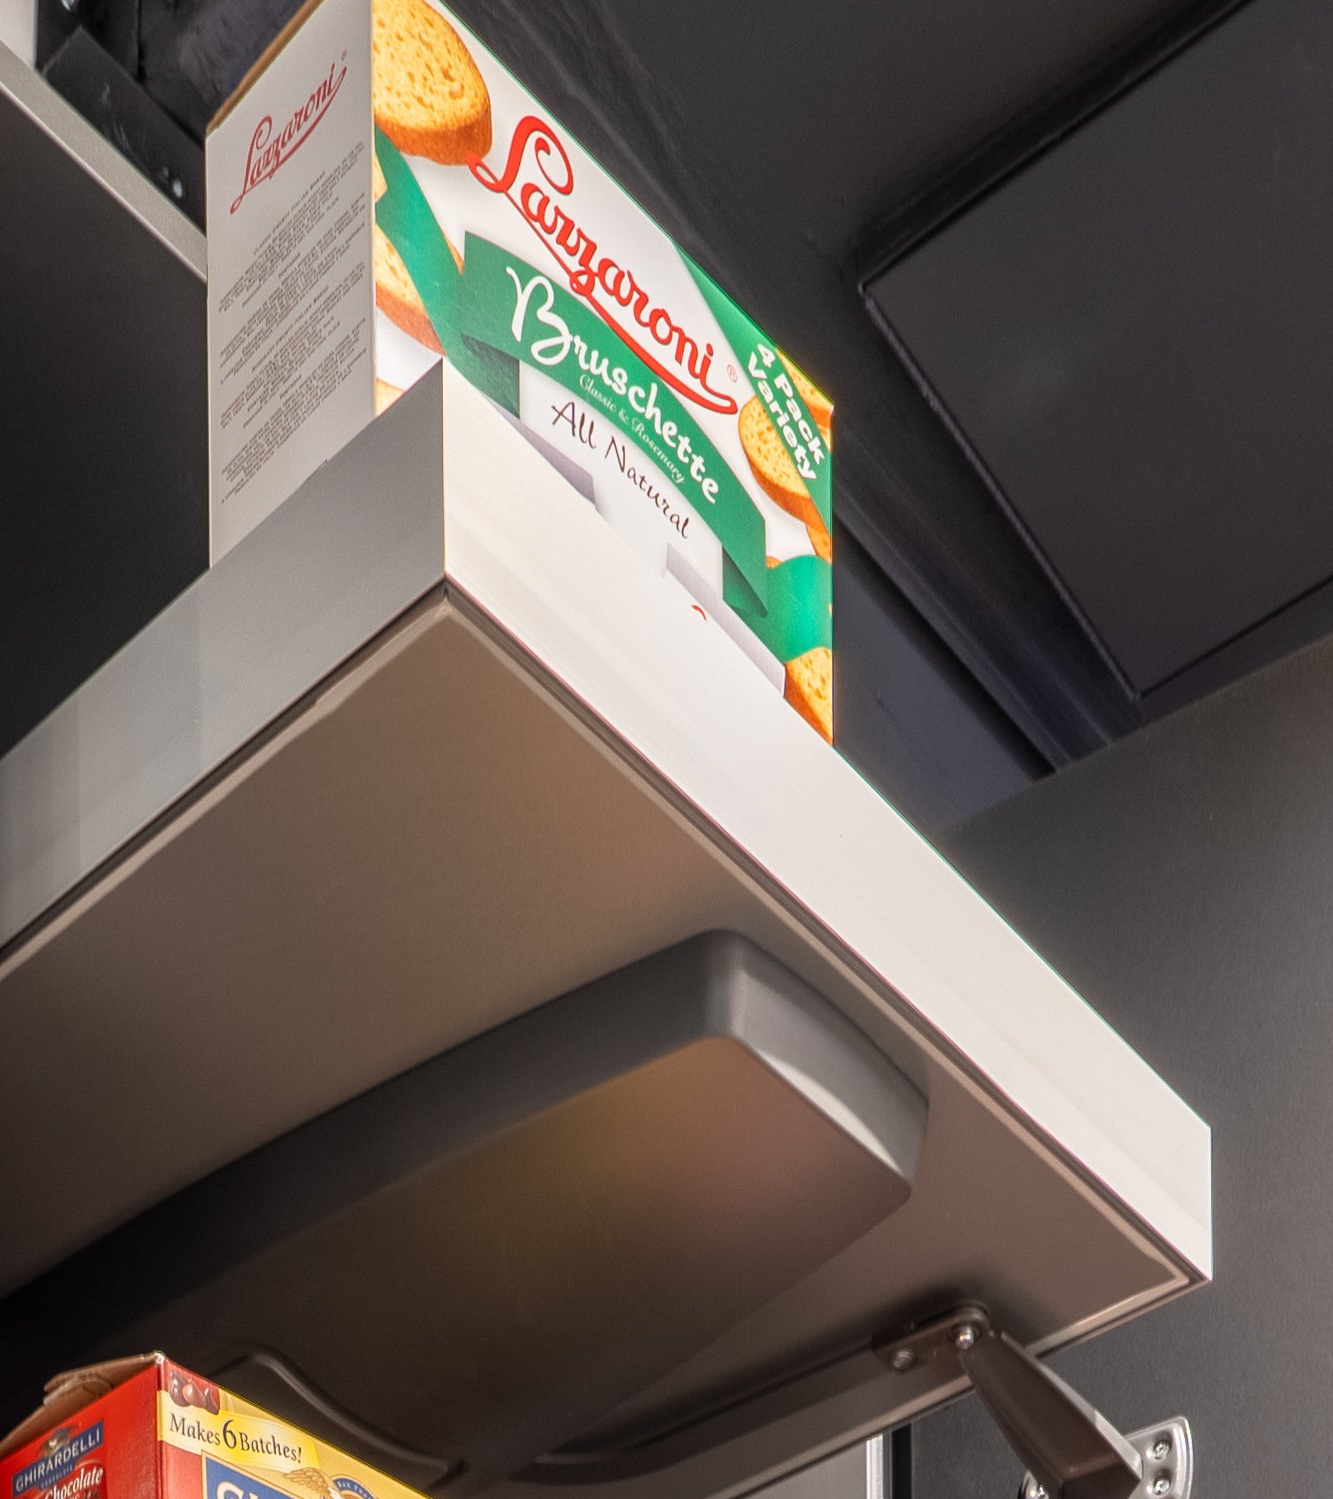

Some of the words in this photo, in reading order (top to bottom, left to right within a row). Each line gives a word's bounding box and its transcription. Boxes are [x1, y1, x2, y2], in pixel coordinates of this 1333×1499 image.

[230, 62, 347, 215] Lazzaroni
[468, 114, 738, 415] Lazzaroni
[506, 266, 718, 504] Bruschette
[579, 375, 617, 413] Classic
[631, 418, 685, 484] Rosemary
[748, 352, 816, 480] Variety
[757, 344, 776, 368] 4
[774, 373, 826, 465] Pack
[551, 401, 596, 449] All
[605, 436, 689, 539] Natural
[15, 1428, 101, 1493] GHIRARDELLI
[170, 1413, 221, 1446] Makes
[222, 1419, 237, 1449] 6
[239, 1432, 302, 1463] Batches!
